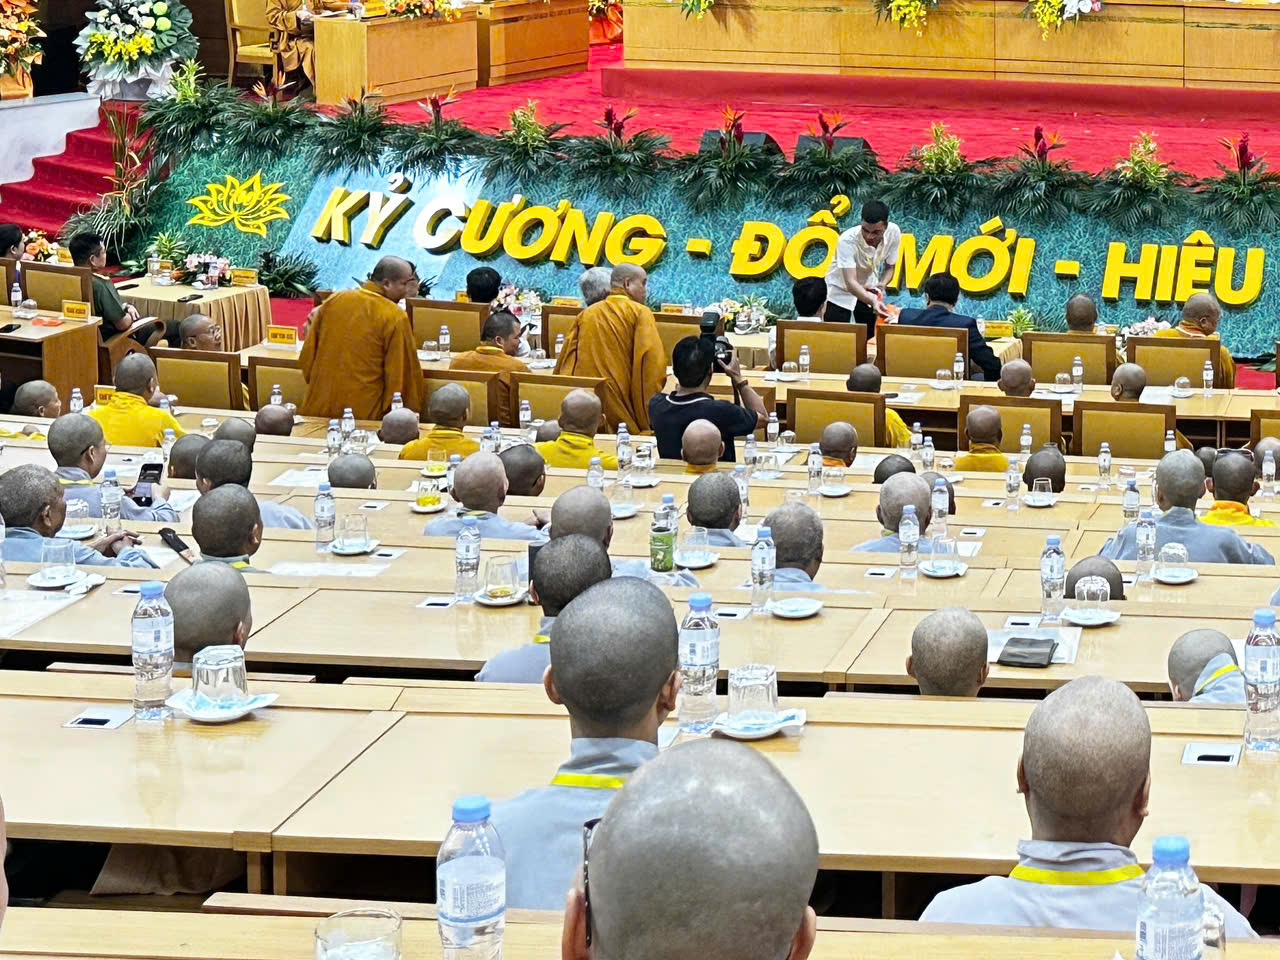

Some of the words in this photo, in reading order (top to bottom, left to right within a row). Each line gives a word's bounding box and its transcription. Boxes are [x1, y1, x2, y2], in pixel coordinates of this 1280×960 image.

[312, 172, 413, 248] KỶ
[413, 194, 667, 268] CƯƠNG
[687, 238, 712, 258] -
[729, 194, 851, 280] ĐỔ
[887, 216, 1035, 296] MỚI
[1055, 260, 1080, 277] -
